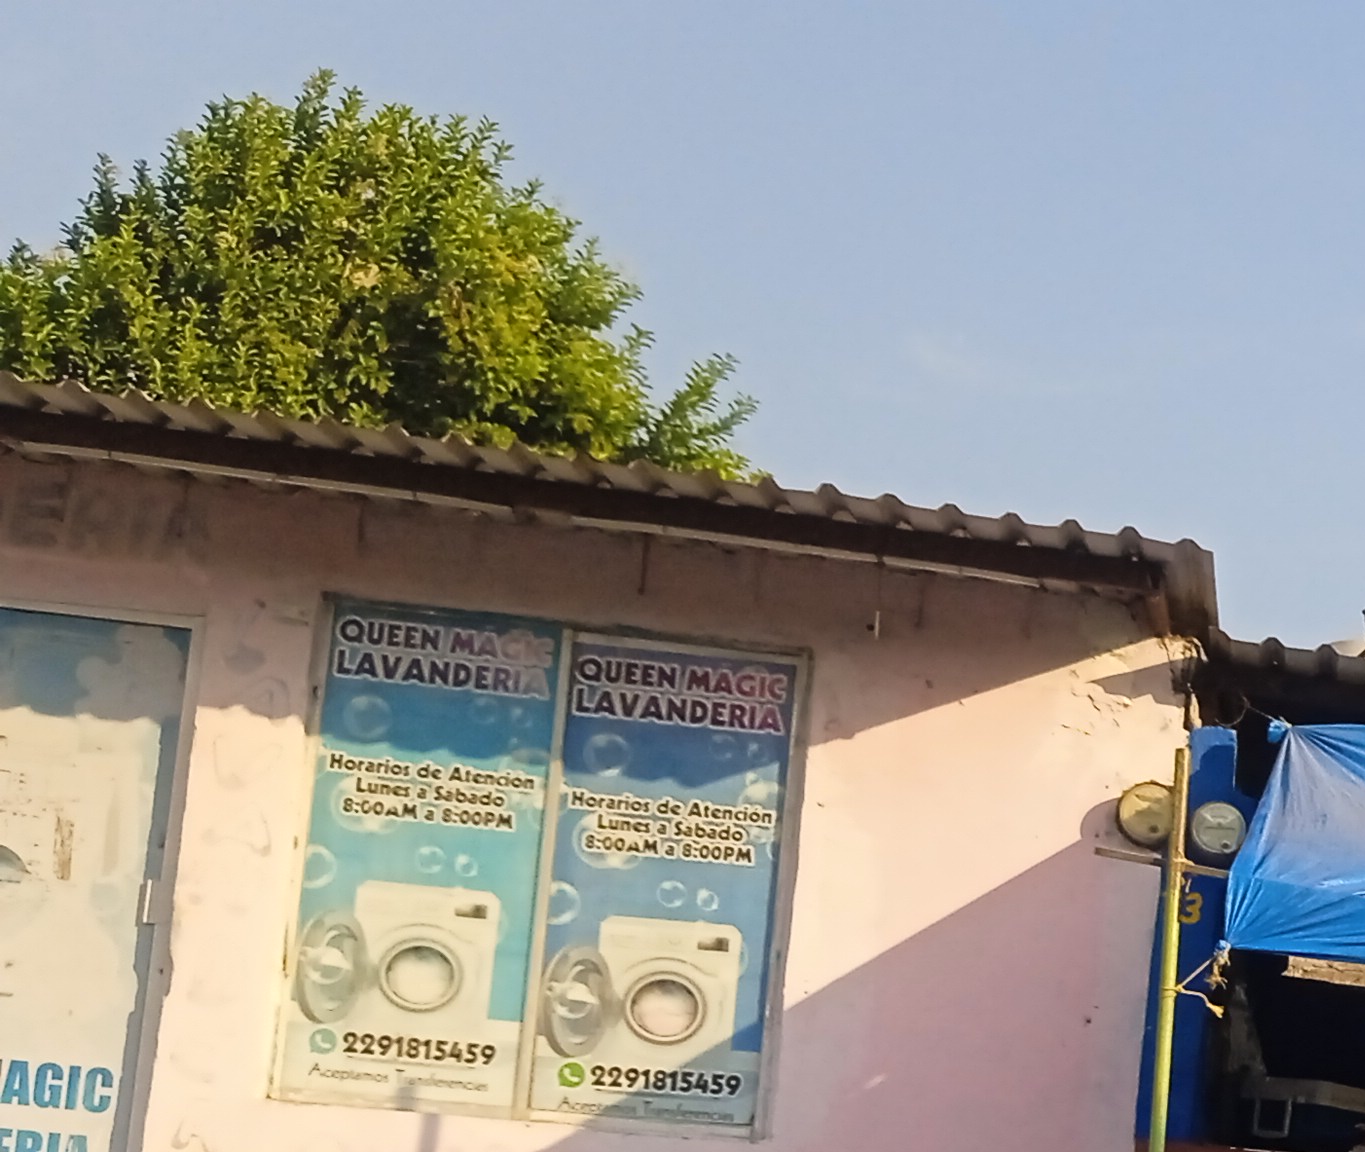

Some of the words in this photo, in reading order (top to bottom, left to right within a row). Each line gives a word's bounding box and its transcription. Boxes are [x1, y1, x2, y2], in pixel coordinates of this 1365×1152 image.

[340, 618, 440, 651] QUEEN
[450, 630, 553, 666] MAGIC
[336, 650, 548, 696] LAVANDERIA
[579, 657, 677, 689] QUEEN
[687, 668, 787, 700] MAGIC
[575, 688, 782, 732] LAVANDERIA
[329, 754, 410, 777] Horarios
[416, 764, 442, 781] de
[356, 778, 411, 798] Lunes
[417, 788, 428, 800] a
[434, 786, 505, 807] Sabado
[571, 791, 650, 813] Horarios
[656, 800, 682, 817] de
[424, 809, 435, 822] a
[442, 808, 513, 829] 8:00PM
[597, 814, 650, 834] Lunes
[657, 823, 667, 835] a
[674, 821, 743, 842] Sabado
[665, 845, 675, 857] a
[682, 843, 752, 863] 8:00PM
[342, 1031, 496, 1065] 2291815459
[0, 1058, 114, 1113] AGIC
[590, 1065, 742, 1096] 2291815459
